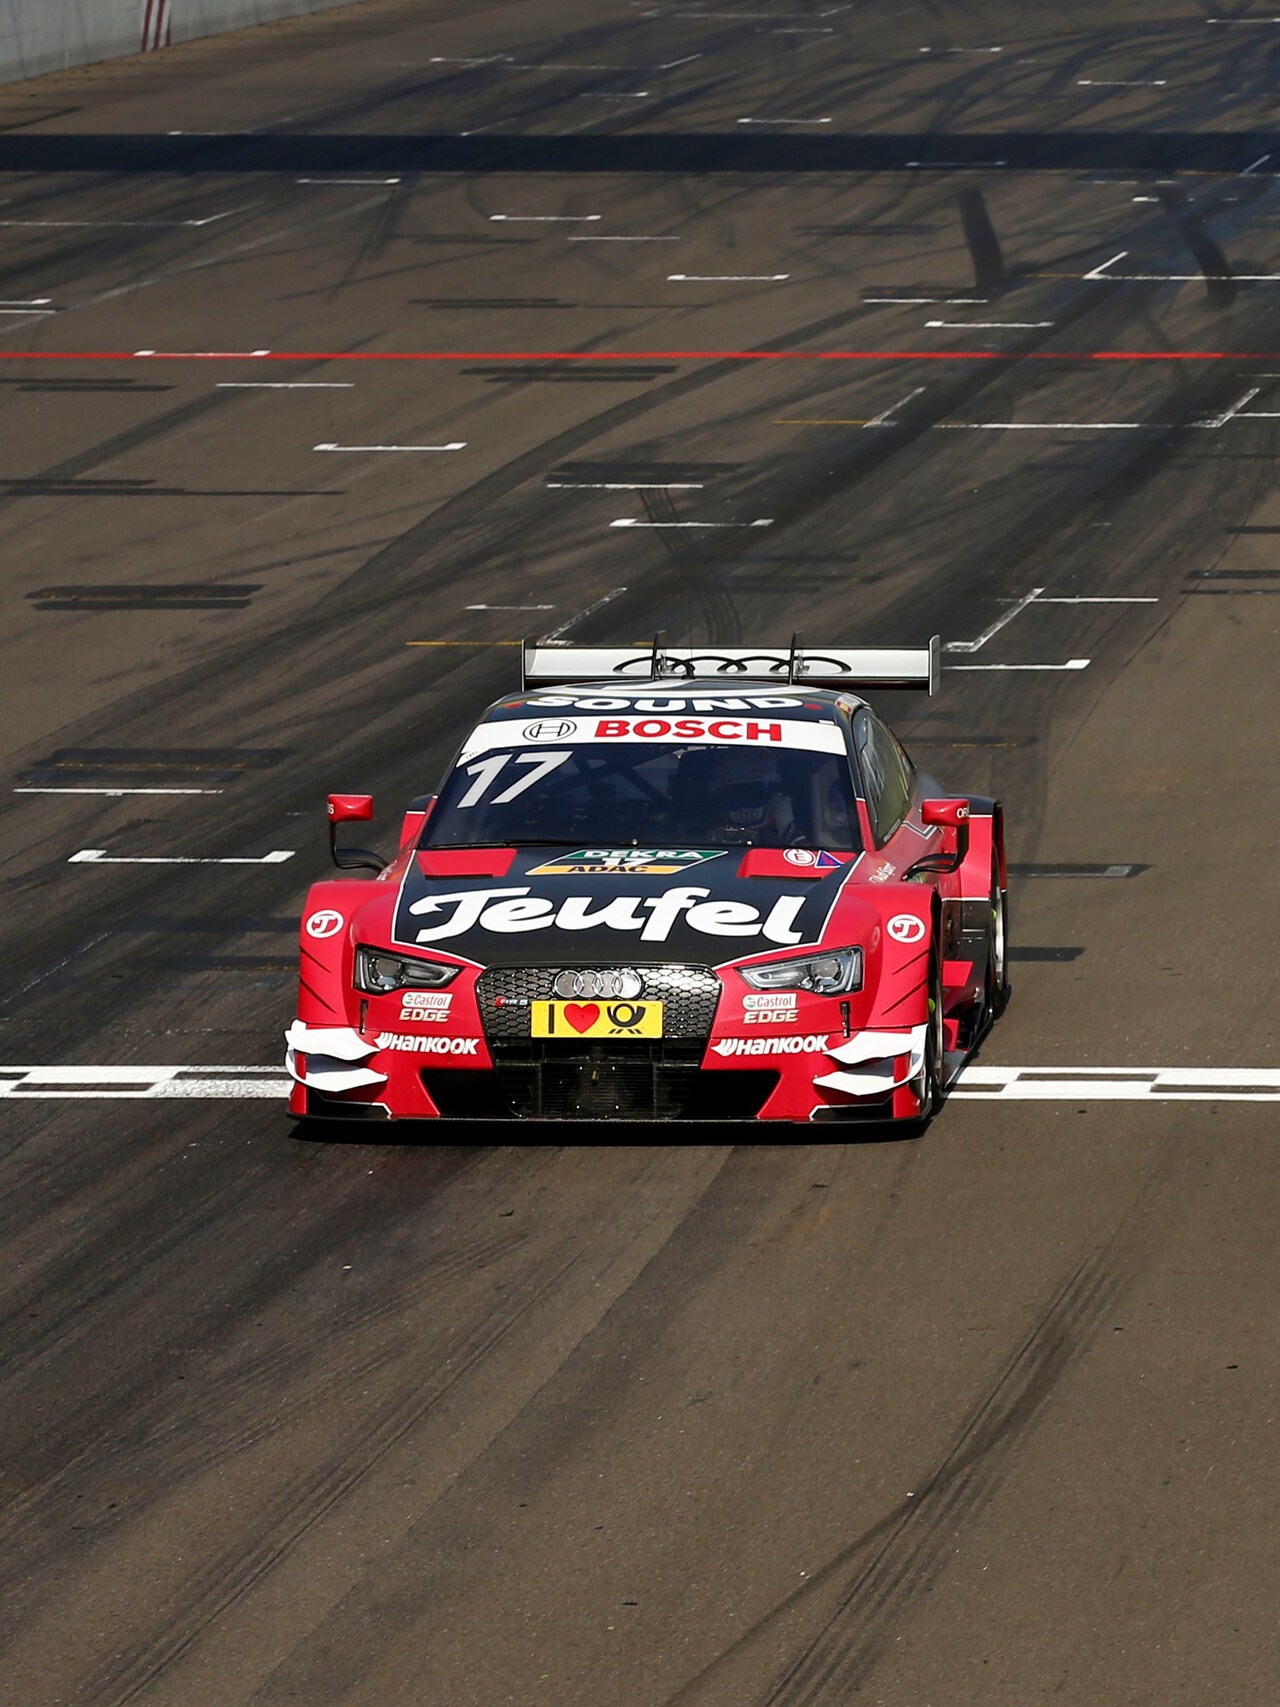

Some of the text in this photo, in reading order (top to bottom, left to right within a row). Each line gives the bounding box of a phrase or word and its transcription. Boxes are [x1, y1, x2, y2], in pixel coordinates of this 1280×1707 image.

[526, 696, 803, 712] SOUND
[594, 719, 782, 742] BOSCH
[456, 750, 574, 809] 17
[583, 850, 704, 859] DEKRA
[601, 857, 657, 867] 17
[409, 886, 807, 944] Teufel
[413, 994, 448, 1007] Castrol
[757, 996, 793, 1008] Castrol
[399, 1008, 451, 1022] EDGE
[743, 1010, 800, 1024] EDGE
